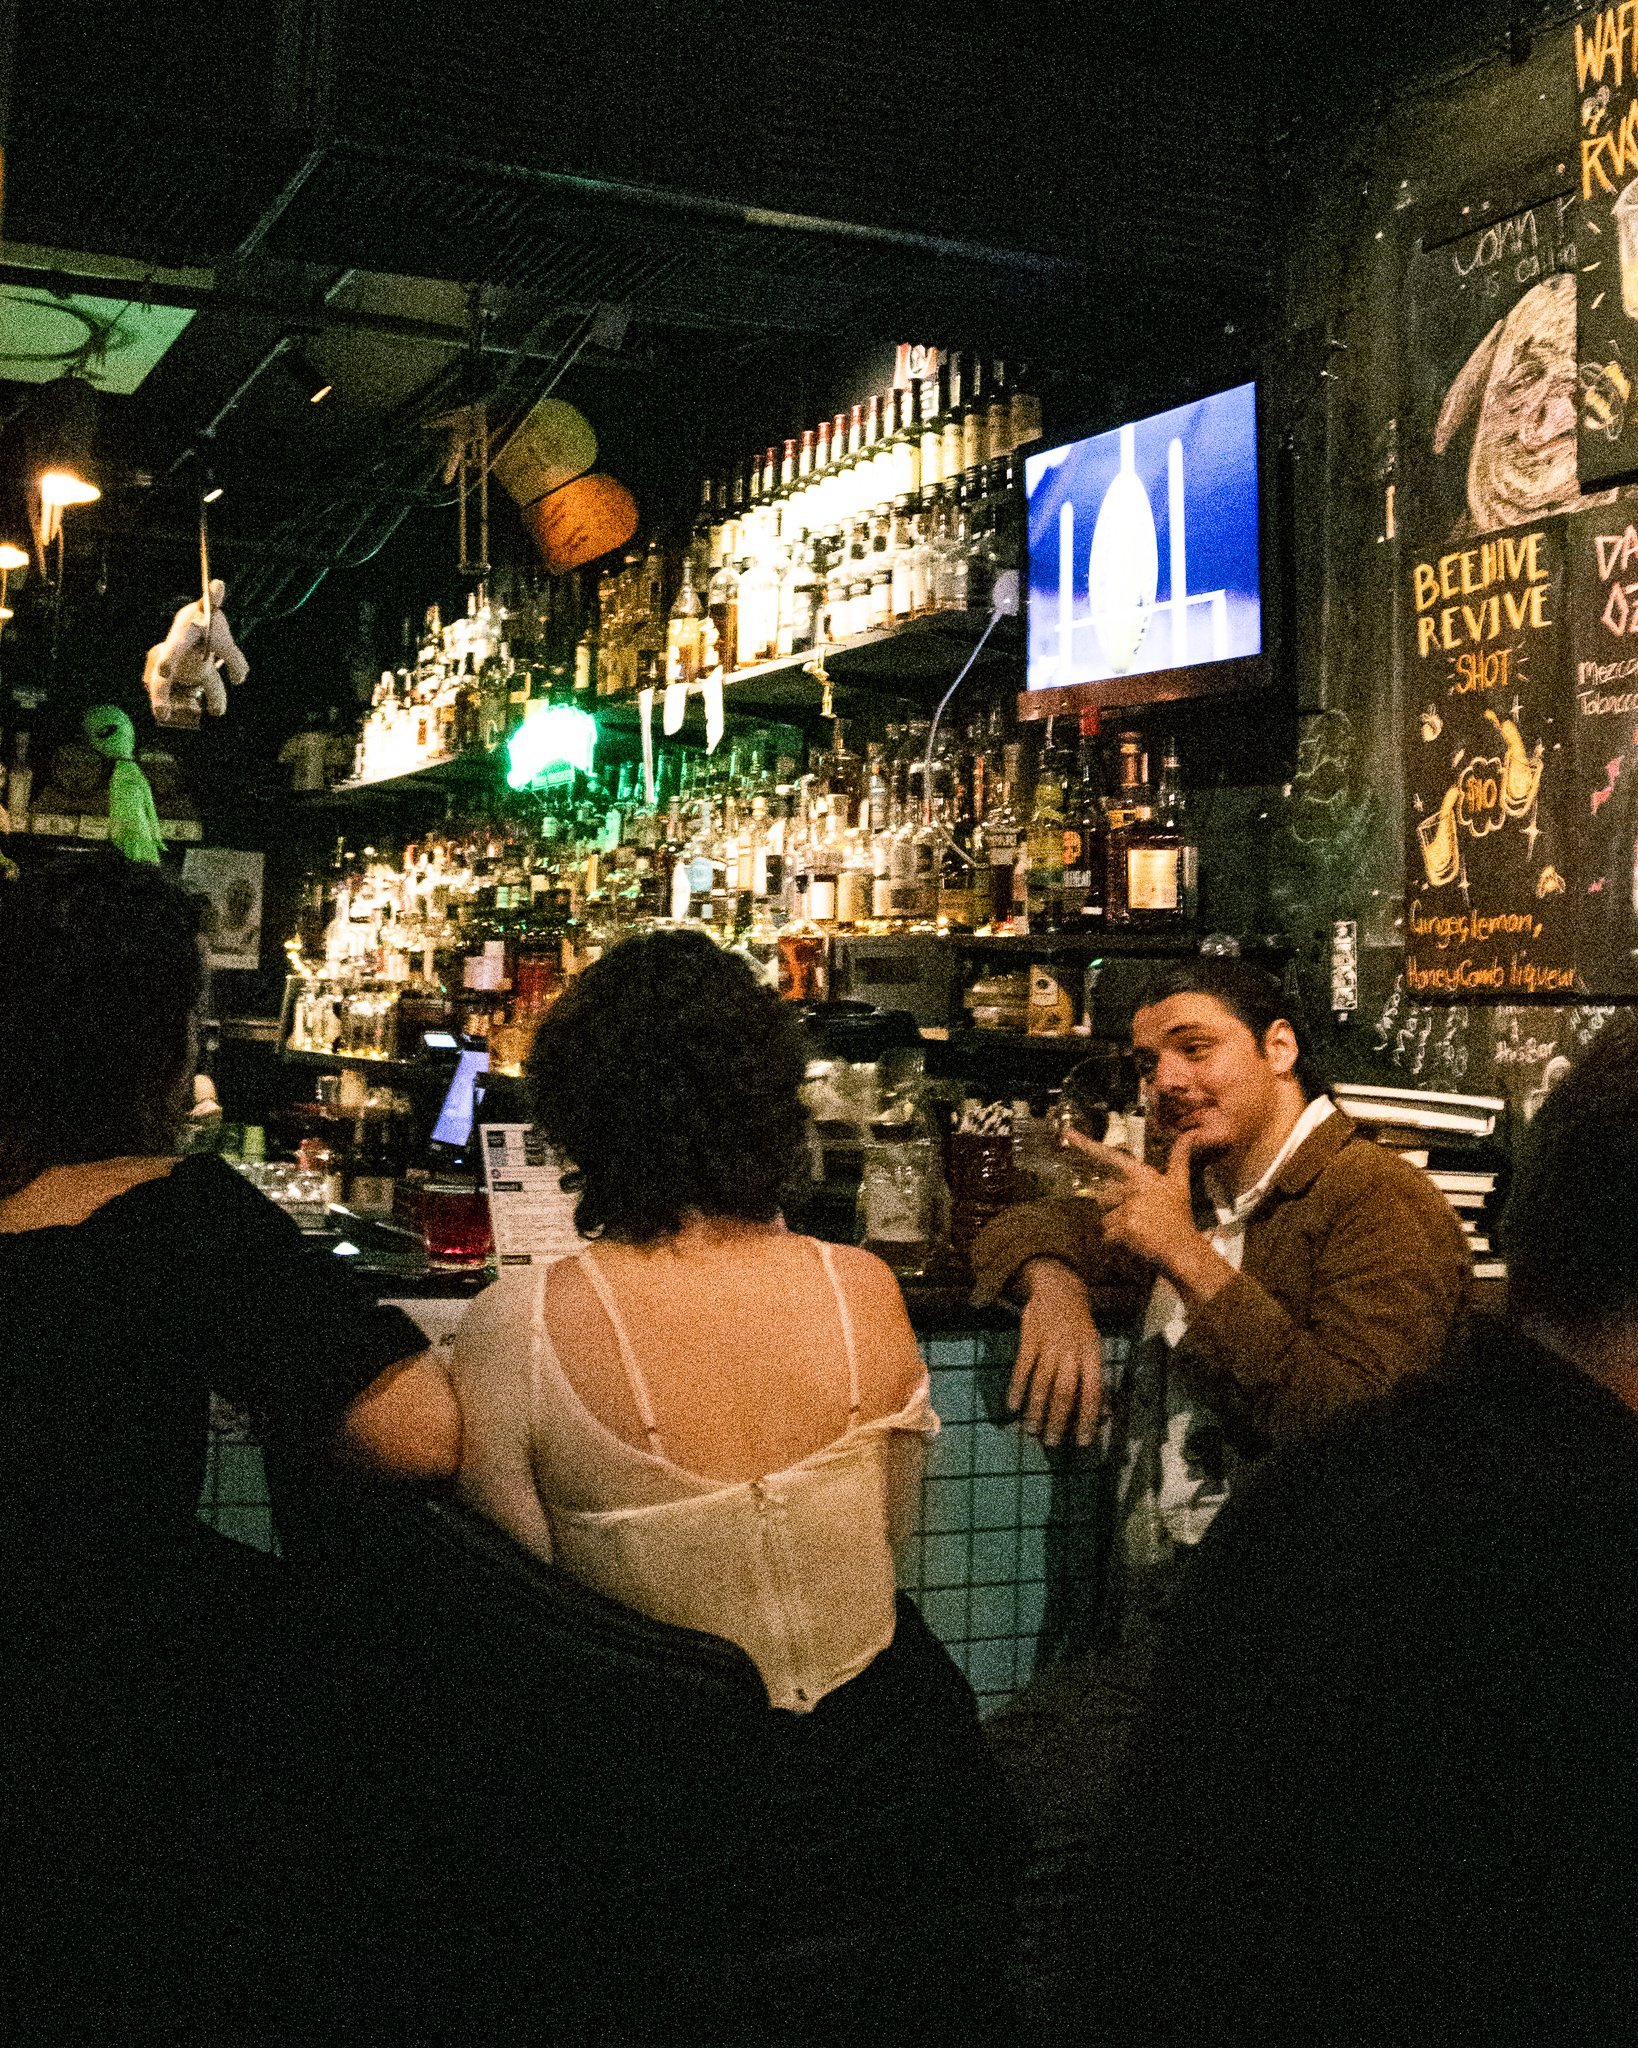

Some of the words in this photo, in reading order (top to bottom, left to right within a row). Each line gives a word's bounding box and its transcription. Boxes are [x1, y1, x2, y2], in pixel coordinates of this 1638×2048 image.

[1413, 532, 1549, 612] BEEHIVE
[1418, 583, 1552, 658] REVIVE
[1456, 650, 1513, 694] SHOT
